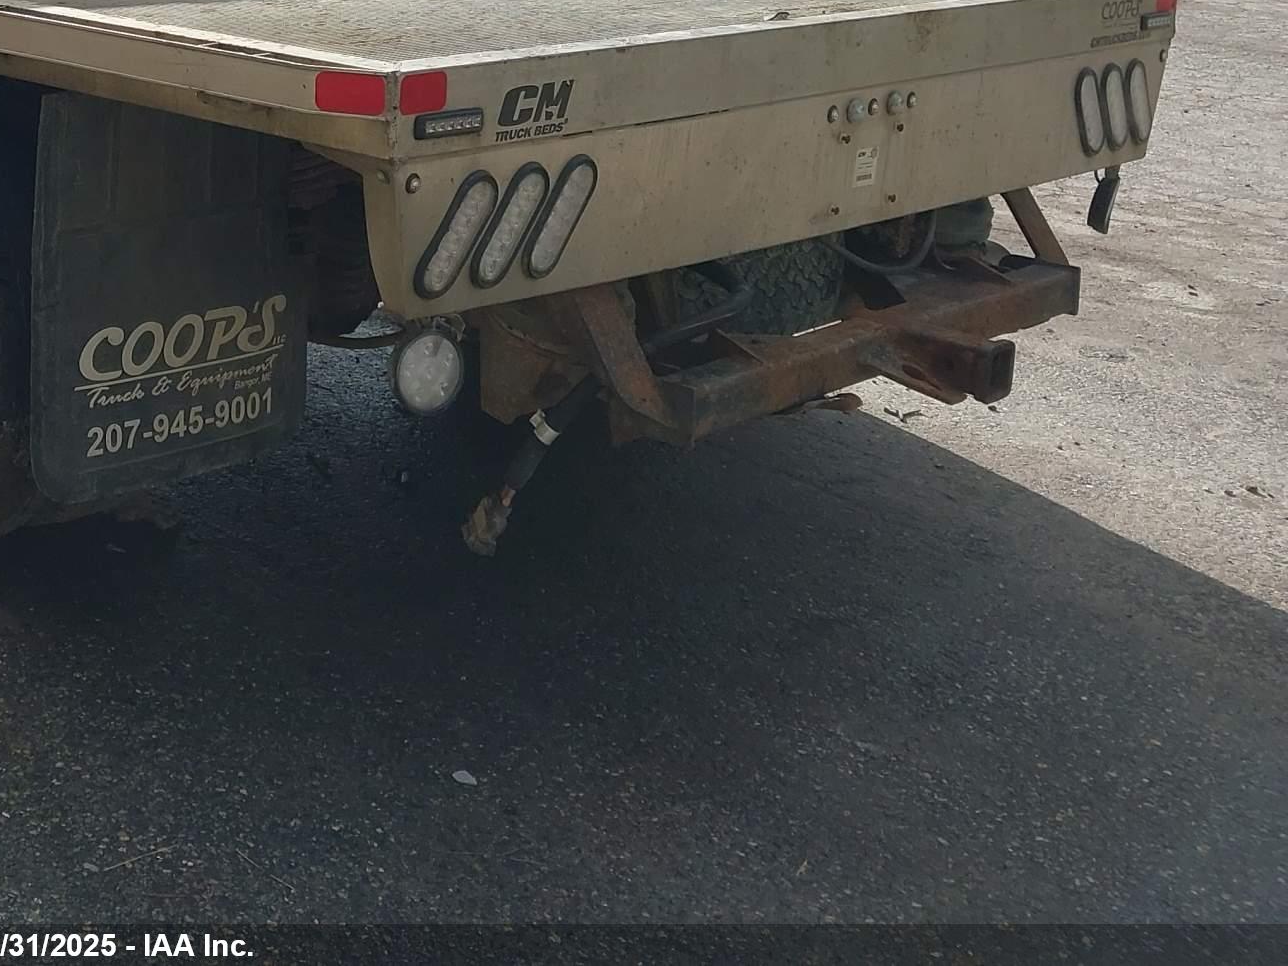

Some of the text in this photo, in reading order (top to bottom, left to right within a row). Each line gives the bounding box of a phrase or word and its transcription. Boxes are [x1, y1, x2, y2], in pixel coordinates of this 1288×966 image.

[497, 79, 575, 127] CM
[495, 122, 564, 142] TRUCK BEDS
[78, 294, 288, 381] COOP'S
[86, 354, 278, 409] Truck & Equipment
[86, 387, 273, 458] 207-945-9001
